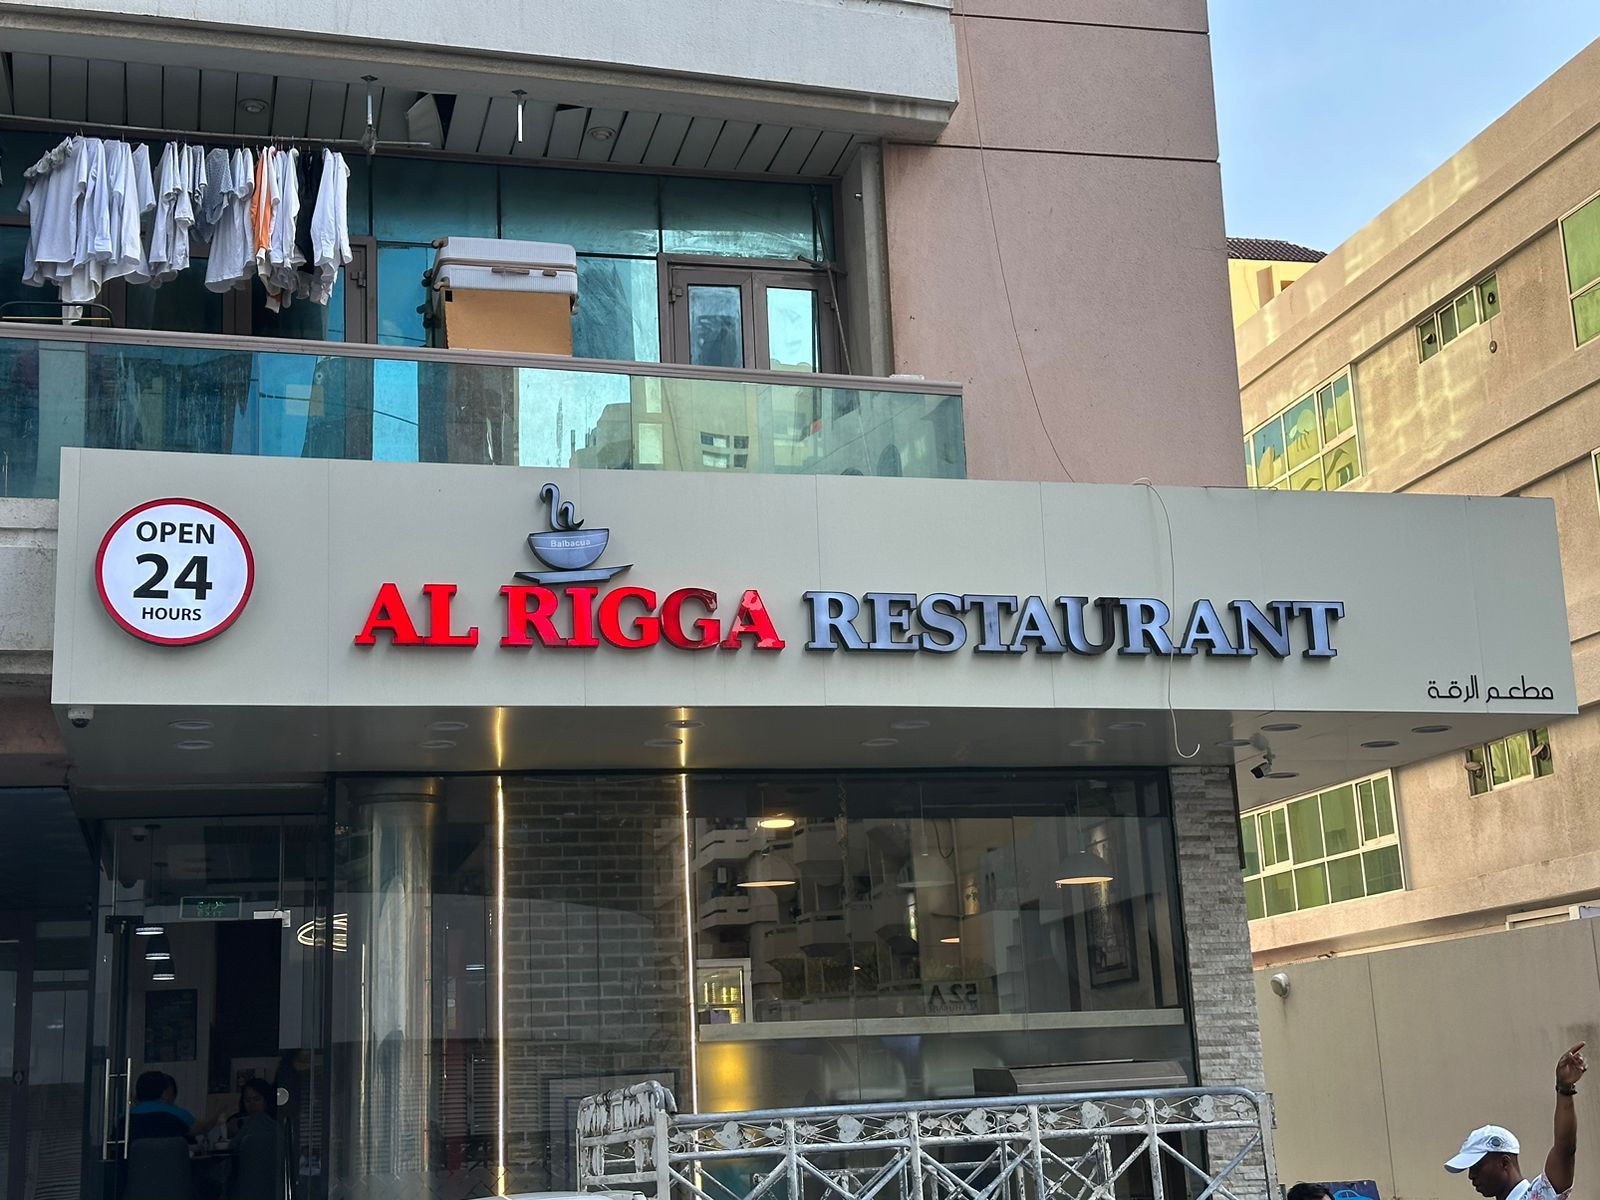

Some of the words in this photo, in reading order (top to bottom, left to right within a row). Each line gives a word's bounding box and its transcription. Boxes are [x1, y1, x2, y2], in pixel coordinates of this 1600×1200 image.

[136, 520, 215, 544] OPEN
[550, 539, 591, 548] Balbacua
[133, 553, 213, 601] 24
[141, 607, 202, 621] HOURS
[354, 583, 479, 648] AL
[499, 585, 786, 651] RIGGA
[803, 590, 1345, 659] RESTAURANT
[1427, 674, 1479, 703] الرقة
[1486, 675, 1554, 703] مطعم
